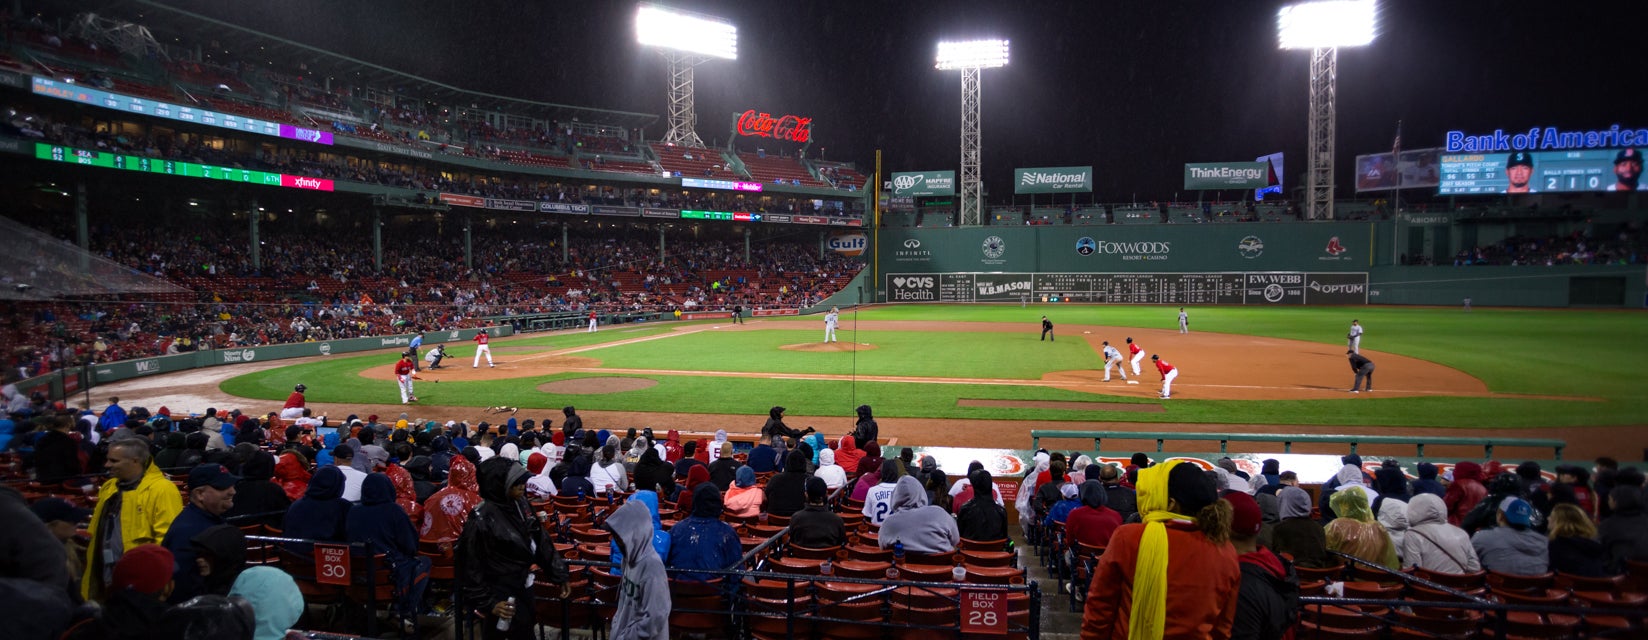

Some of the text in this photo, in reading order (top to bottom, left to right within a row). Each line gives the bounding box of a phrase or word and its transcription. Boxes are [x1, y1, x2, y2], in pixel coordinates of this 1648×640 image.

[737, 109, 812, 142] Coca-Cola
[1447, 124, 1648, 152] Bank of America
[78, 150, 92, 158] SEA
[1442, 155, 1485, 163] GALLARDO
[78, 157, 92, 165] BOS
[1036, 172, 1086, 183] National
[1190, 167, 1262, 179] ThinkEnergy
[295, 178, 321, 189] xfinity
[1547, 177, 1599, 190] 2 1 0
[541, 203, 570, 211] COLUMBIA
[829, 237, 865, 249] Gulf
[1098, 240, 1170, 254] FOXWOODS
[906, 276, 934, 288] CVS
[1269, 275, 1301, 284] WEBB
[894, 288, 934, 300] Health
[1322, 284, 1363, 294] OPTUM
[875, 490, 893, 501] GRIF
[321, 548, 345, 556] FIELD
[322, 564, 346, 578] 30
[969, 611, 998, 626] 28
